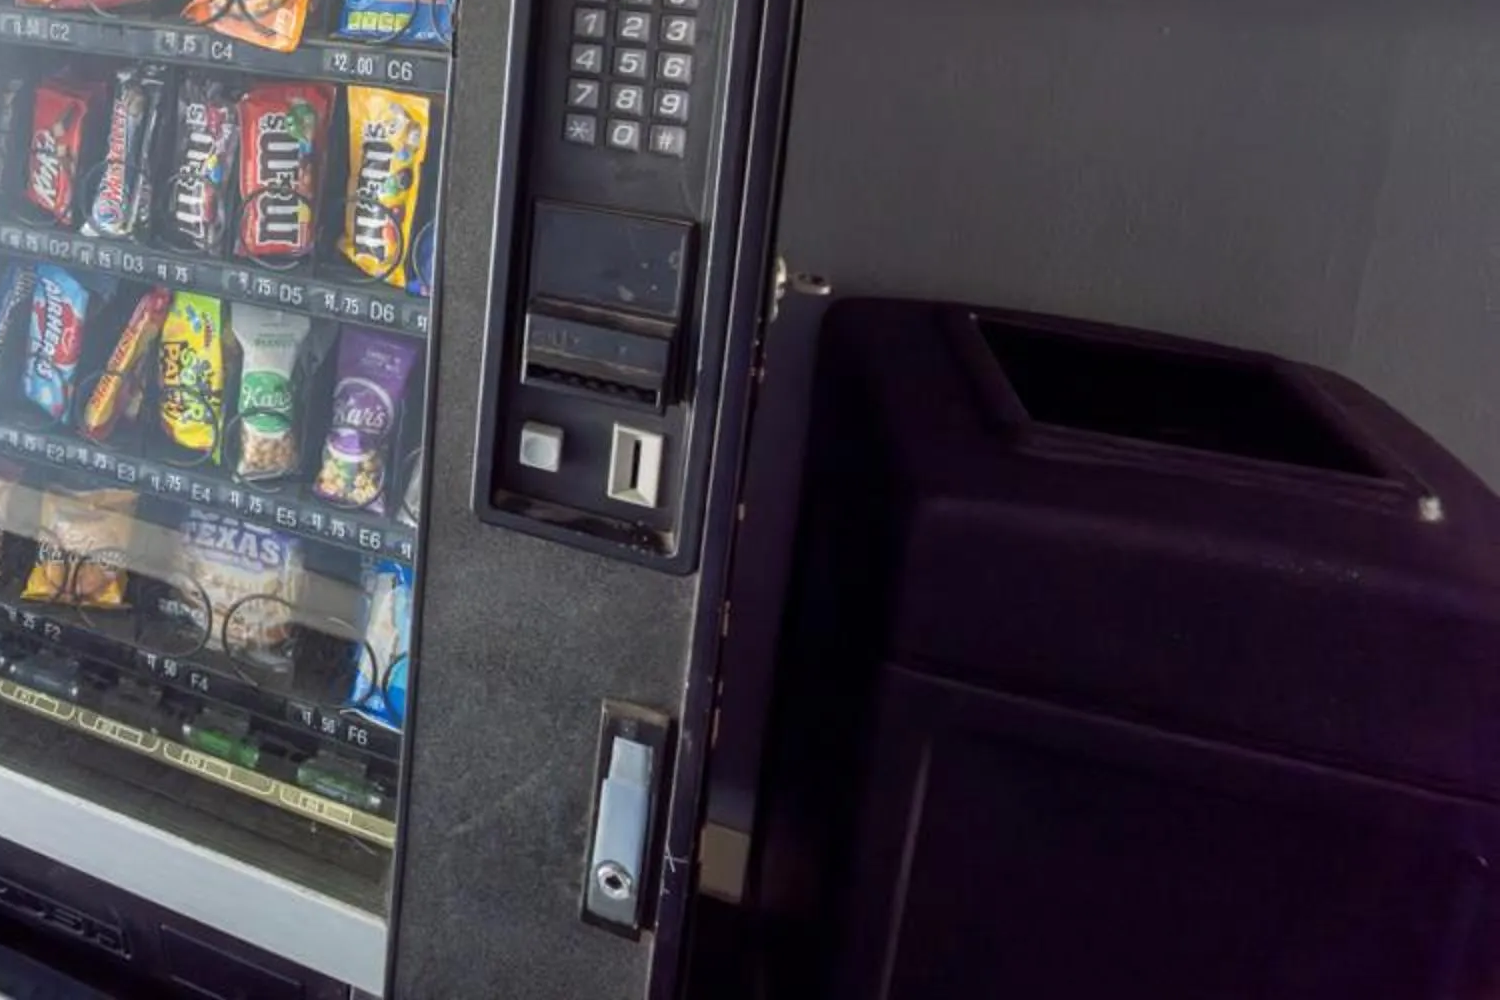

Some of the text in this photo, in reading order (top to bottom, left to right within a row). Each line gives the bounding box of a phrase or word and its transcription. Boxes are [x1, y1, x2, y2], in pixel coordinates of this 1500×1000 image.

[50, 22, 70, 42] C2
[585, 13, 687, 41] 1 2 3
[211, 40, 234, 60] C4
[387, 60, 413, 81] C6
[575, 50, 684, 77] 4 5 6
[575, 83, 680, 114] 7 8 9
[612, 125, 633, 145] 0
[50, 238, 70, 257] D2
[123, 254, 144, 273] D3
[279, 283, 303, 304] D5
[370, 301, 395, 322] D6
[333, 396, 386, 427] Kar's
[46, 443, 65, 462] E2
[117, 462, 136, 482] E3
[191, 483, 211, 503] E4
[276, 507, 297, 528] E5
[183, 522, 280, 566] TEXAS
[359, 528, 382, 549] E6
[44, 622, 62, 642] F2
[190, 672, 209, 692] F4
[347, 724, 368, 746] F6
